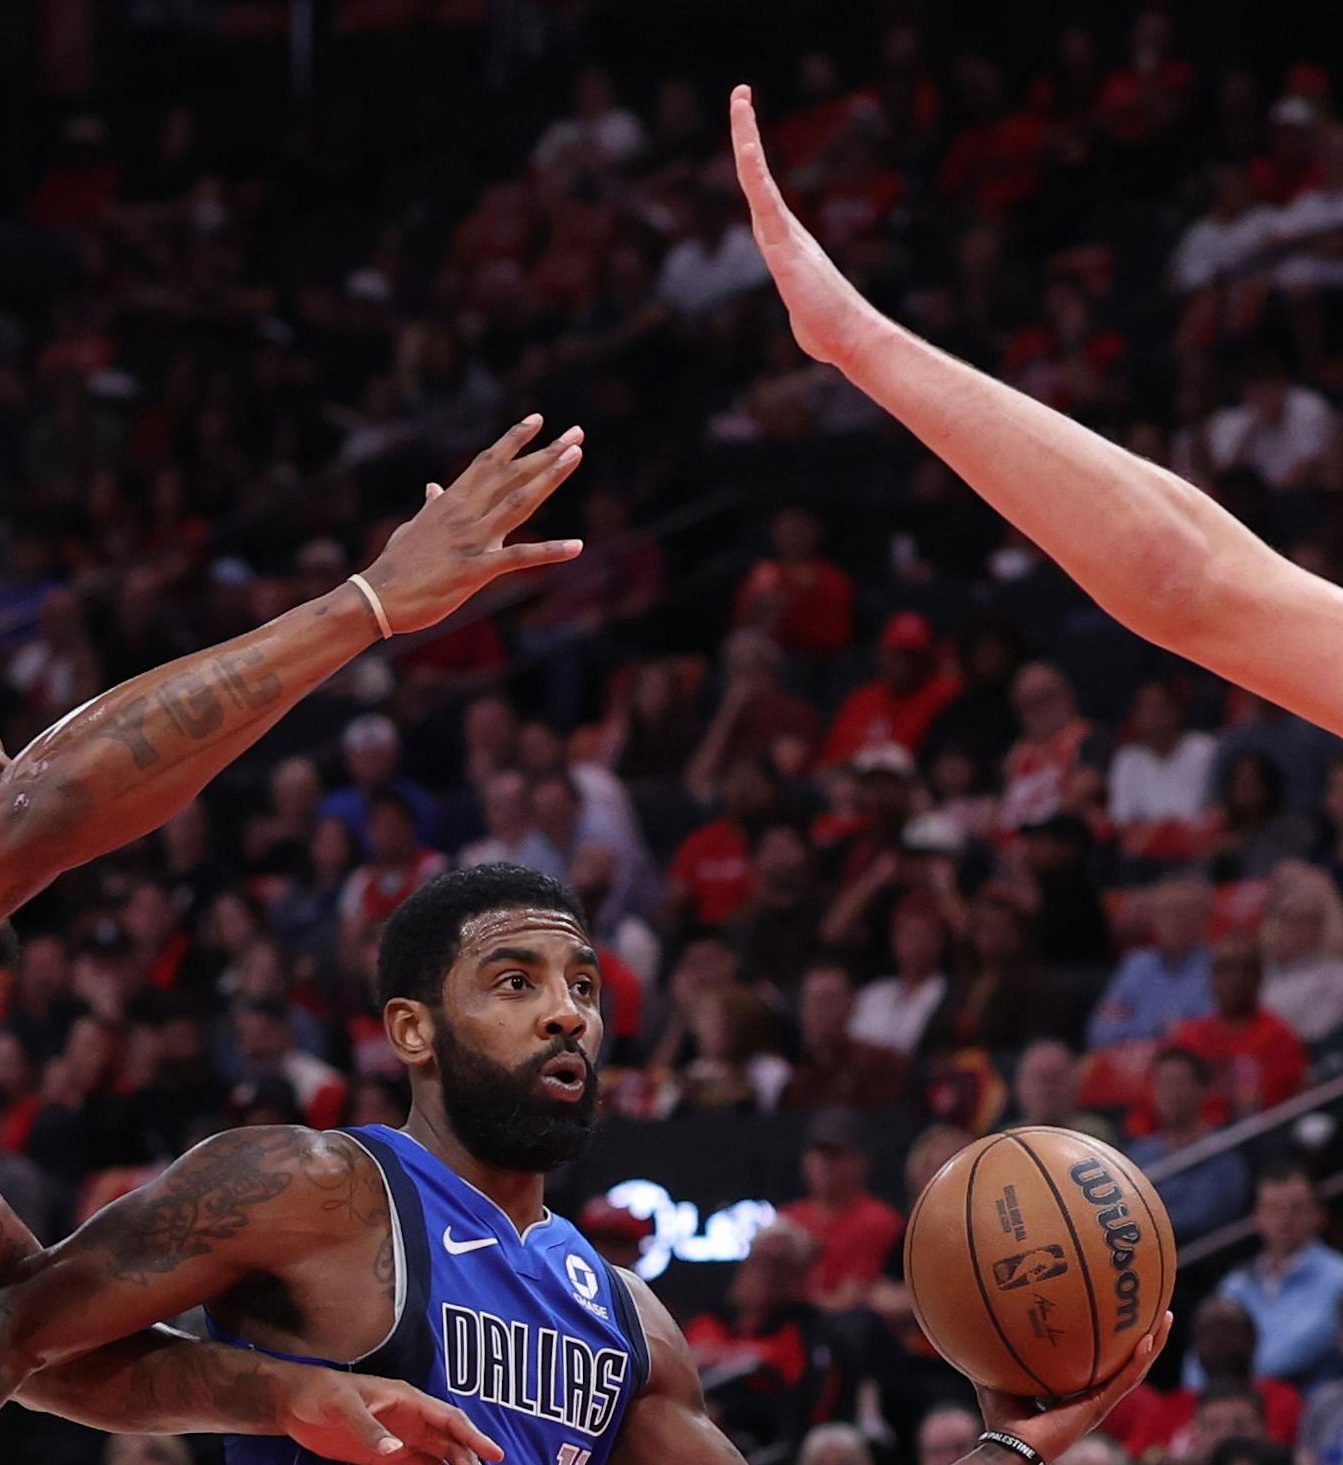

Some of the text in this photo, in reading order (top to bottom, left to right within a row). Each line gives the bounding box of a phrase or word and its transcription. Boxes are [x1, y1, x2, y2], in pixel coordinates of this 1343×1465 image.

[1069, 1157, 1140, 1332] Wilson
[442, 1302, 628, 1437] DALLAS
[987, 1432, 1035, 1459] PALESTINE
